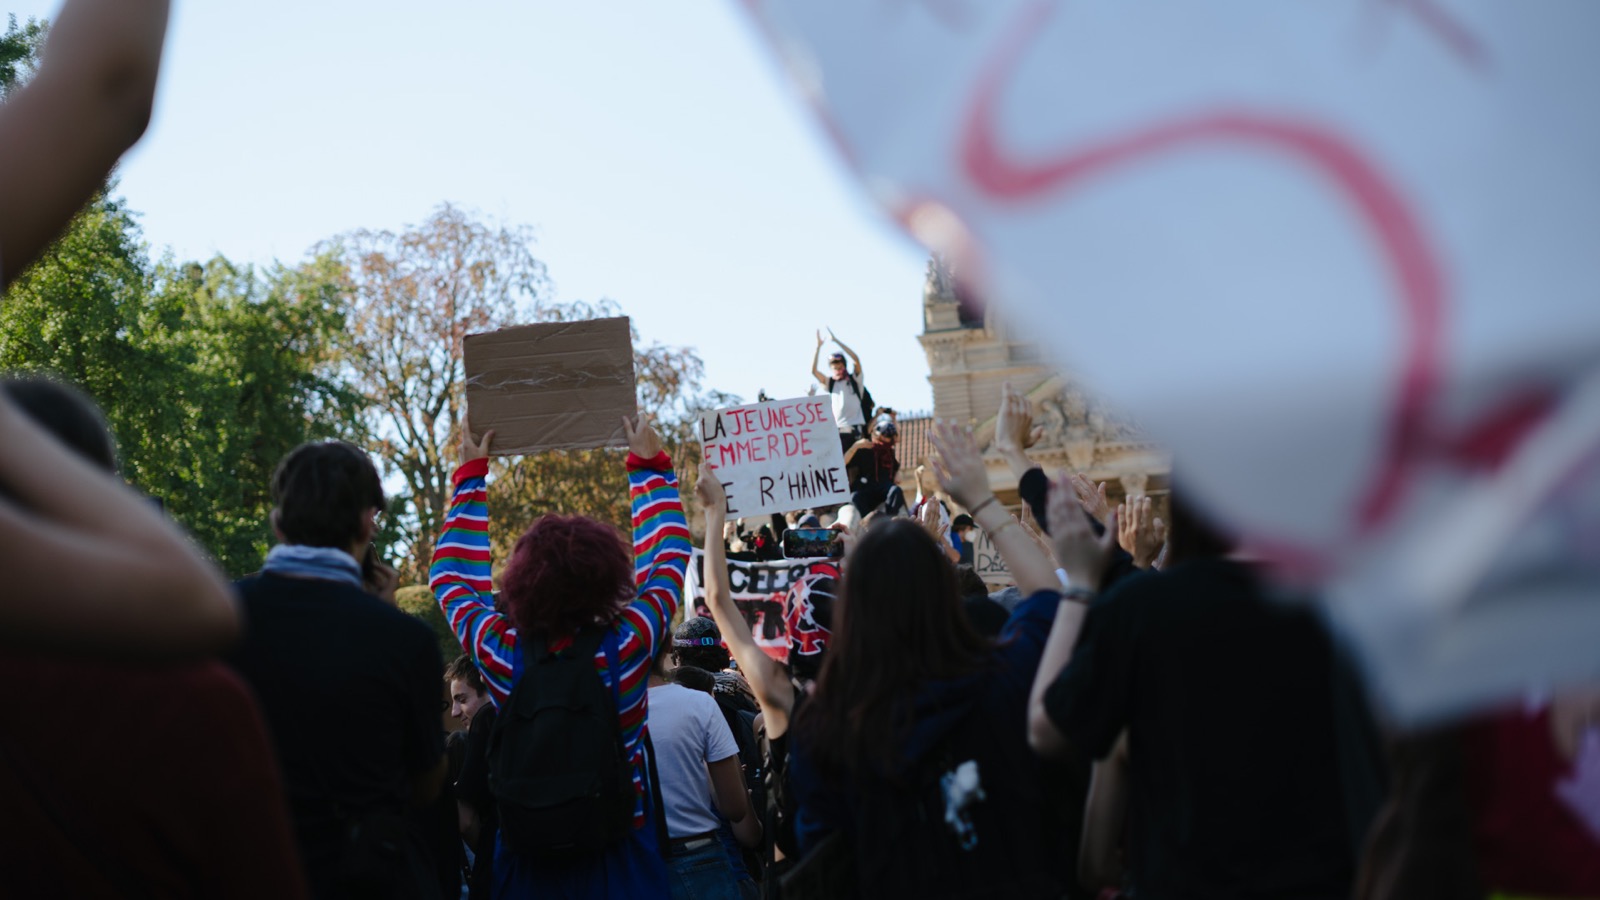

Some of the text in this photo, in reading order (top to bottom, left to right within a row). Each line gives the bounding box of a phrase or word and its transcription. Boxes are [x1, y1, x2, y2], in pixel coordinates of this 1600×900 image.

[702, 403, 828, 442] LA JEUNESSE
[704, 429, 813, 469] EMMERDE
